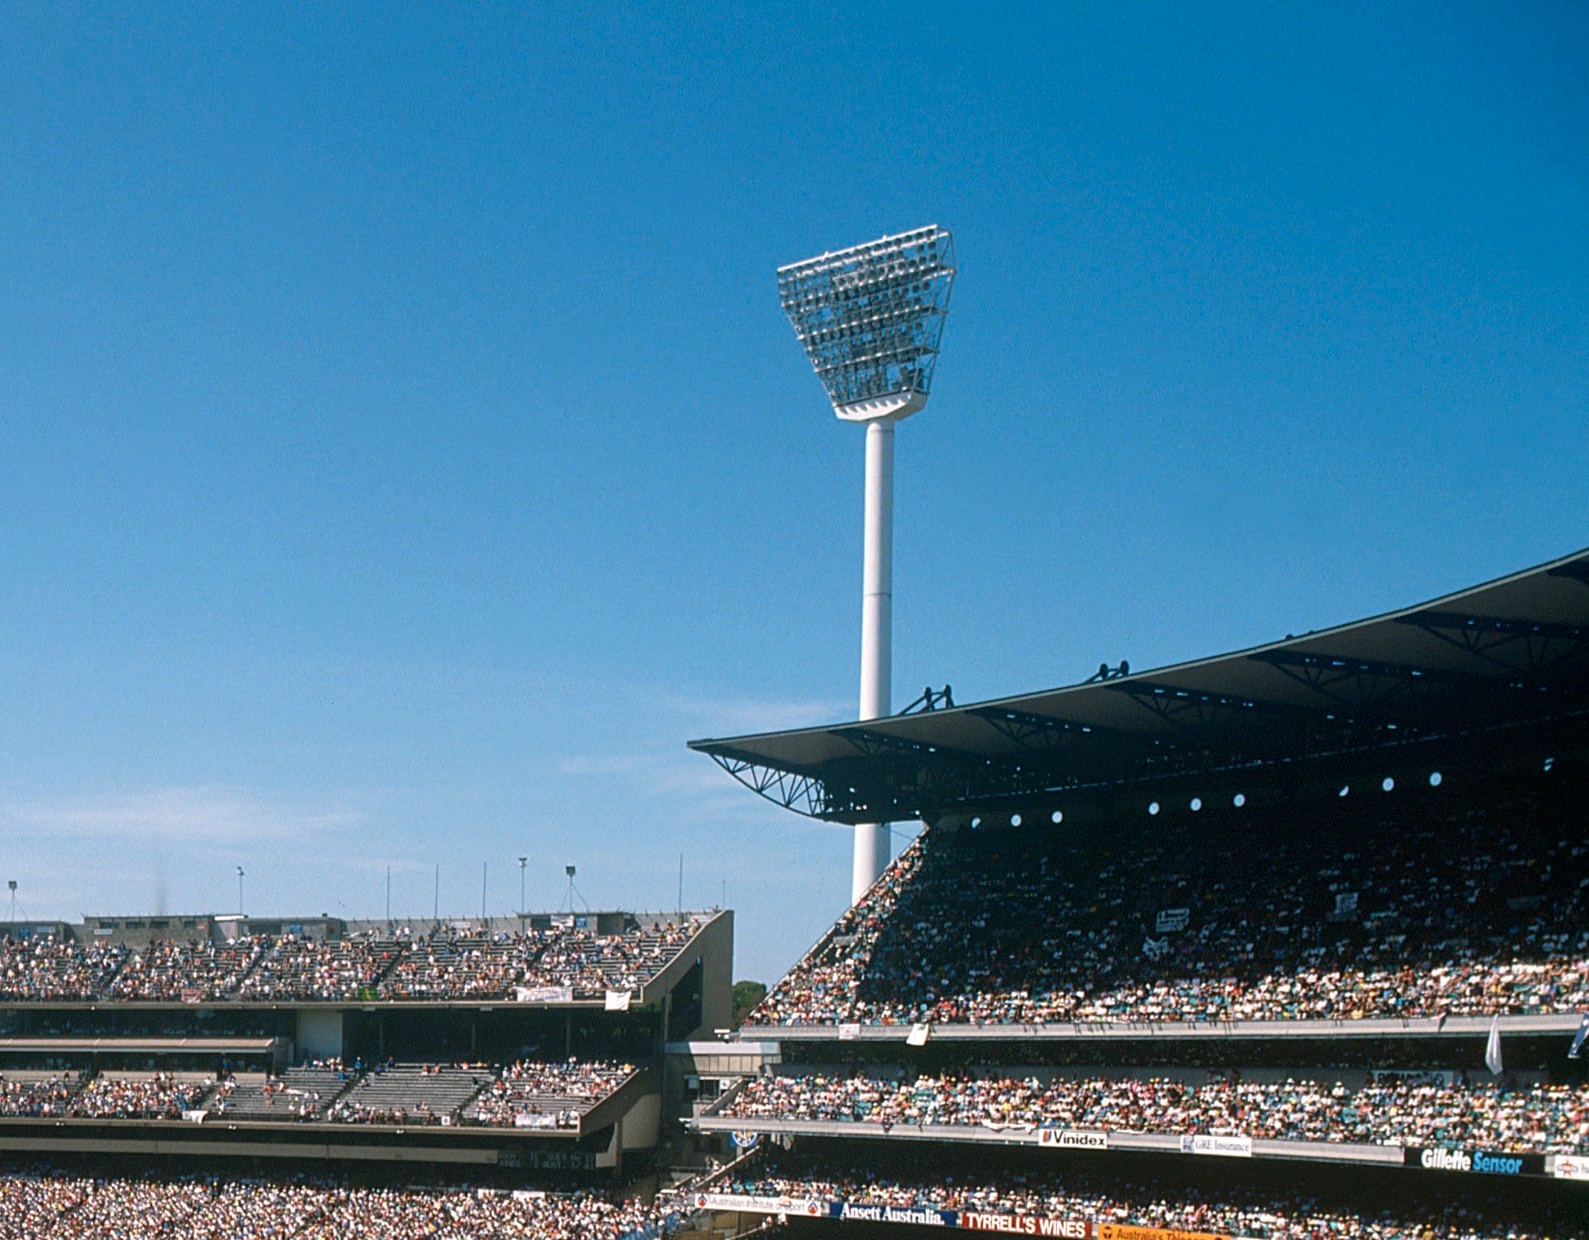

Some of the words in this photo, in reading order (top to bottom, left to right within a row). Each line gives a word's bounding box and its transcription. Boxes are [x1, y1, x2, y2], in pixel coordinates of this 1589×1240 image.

[1053, 1130, 1105, 1146] Vinidex
[1421, 1149, 1471, 1170] Gillette
[1473, 1151, 1522, 1173] Sensor
[841, 1203, 881, 1220] Ansett
[966, 1213, 1035, 1233] TYRRELL'S
[1039, 1219, 1085, 1238] WINES
